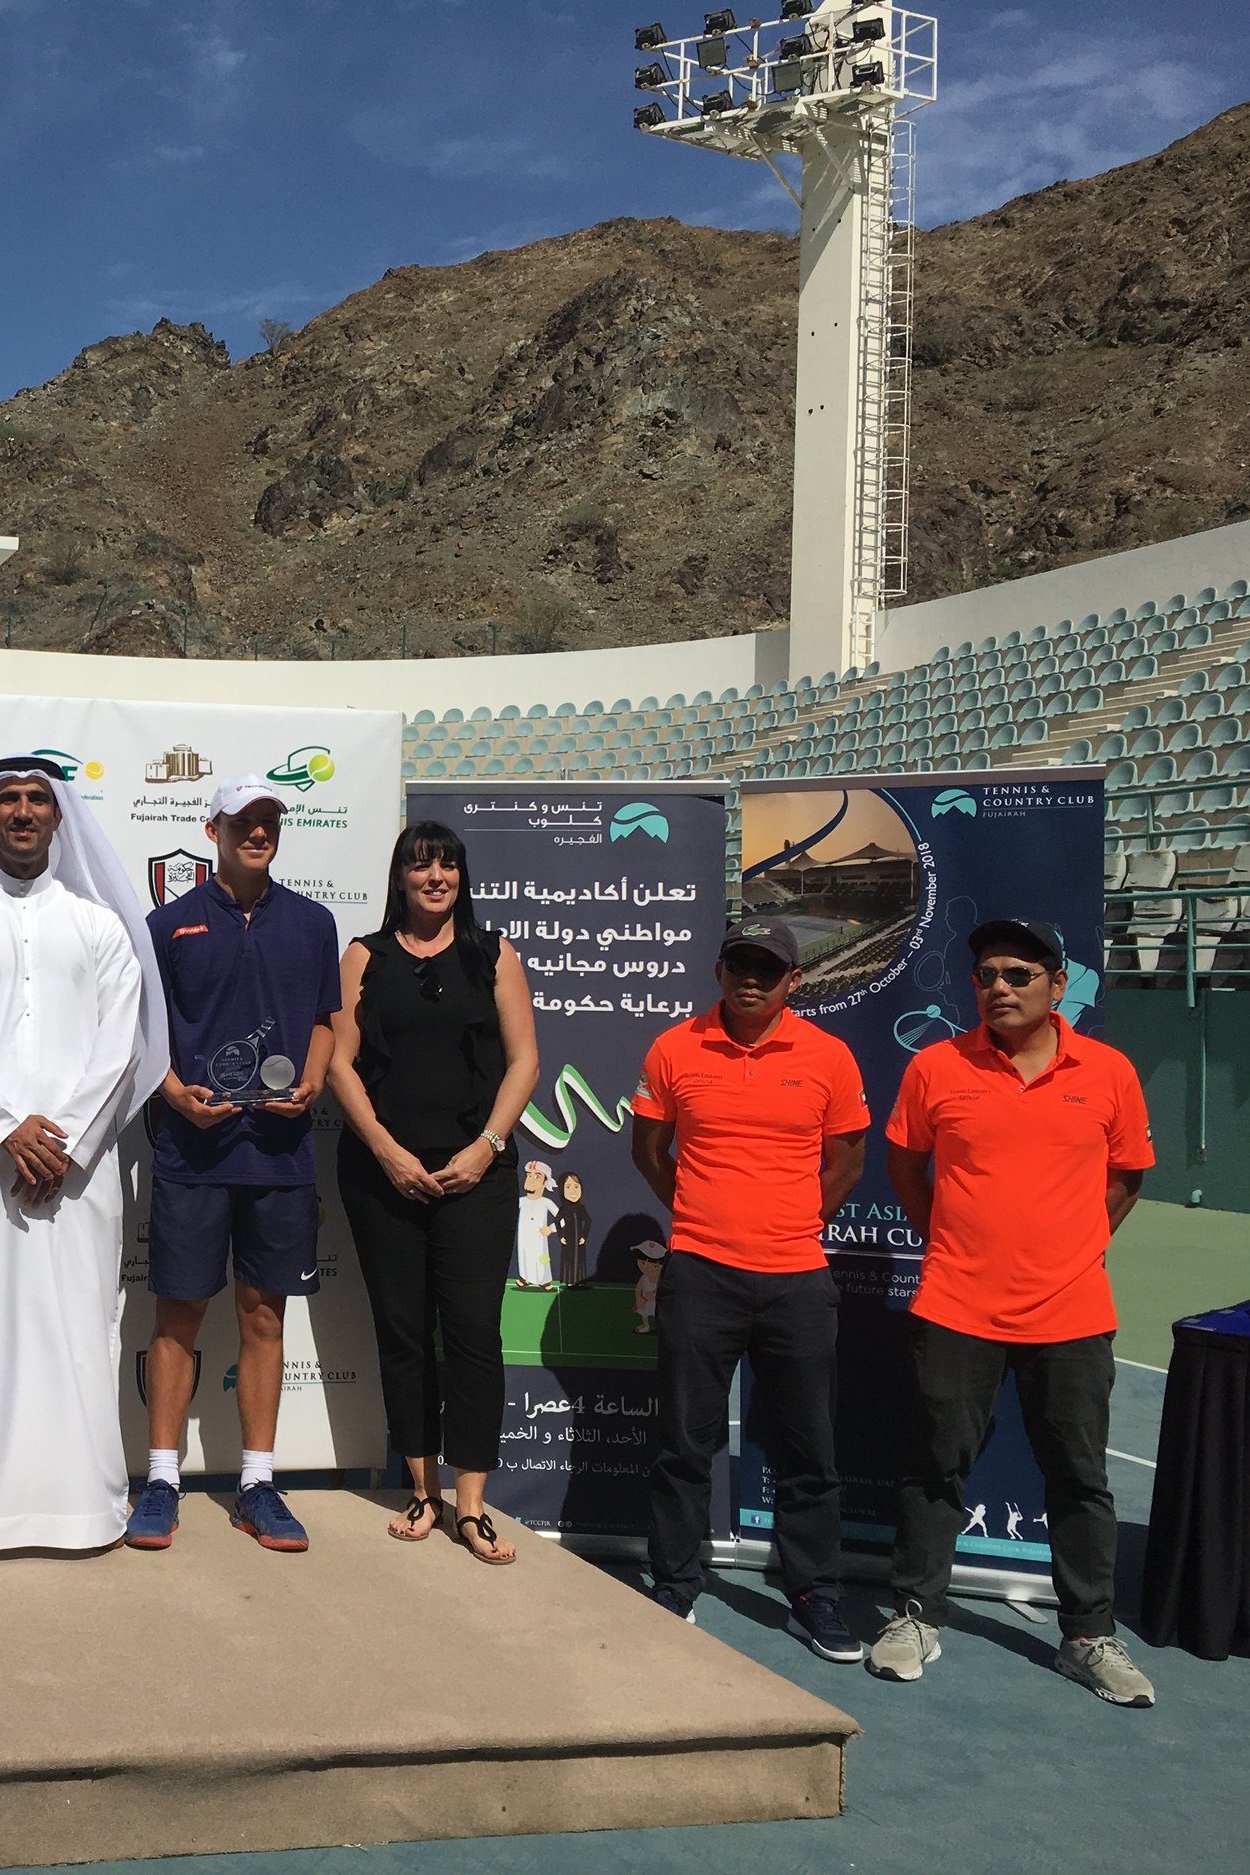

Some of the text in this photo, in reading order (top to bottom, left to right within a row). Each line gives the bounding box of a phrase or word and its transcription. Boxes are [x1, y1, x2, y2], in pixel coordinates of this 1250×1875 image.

[983, 786, 1050, 795] TENNIS &
[983, 795, 1094, 806] COUNTRY CLUB
[130, 813, 168, 823] Fujairah
[982, 810, 1026, 818] FUJAIRAH
[297, 818, 348, 828] EMIRATES
[918, 842, 936, 869] 2018
[327, 880, 334, 888] &
[524, 877, 628, 905] أكاديمية
[339, 892, 368, 900] CLUB
[633, 882, 697, 906] تعلن
[919, 872, 938, 928] November
[535, 922, 692, 951] مواطني دولة
[613, 960, 686, 979] دروس
[869, 960, 908, 995] October
[532, 992, 693, 1017] برعاية حكومة
[820, 1001, 848, 1016] from
[1062, 1094, 1088, 1104] SHINE
[834, 1270, 866, 1280] ennis
[869, 1271, 878, 1281] &
[846, 1282, 884, 1296] future
[328, 1372, 356, 1380] CLUB
[594, 1394, 659, 1416] الساعة
